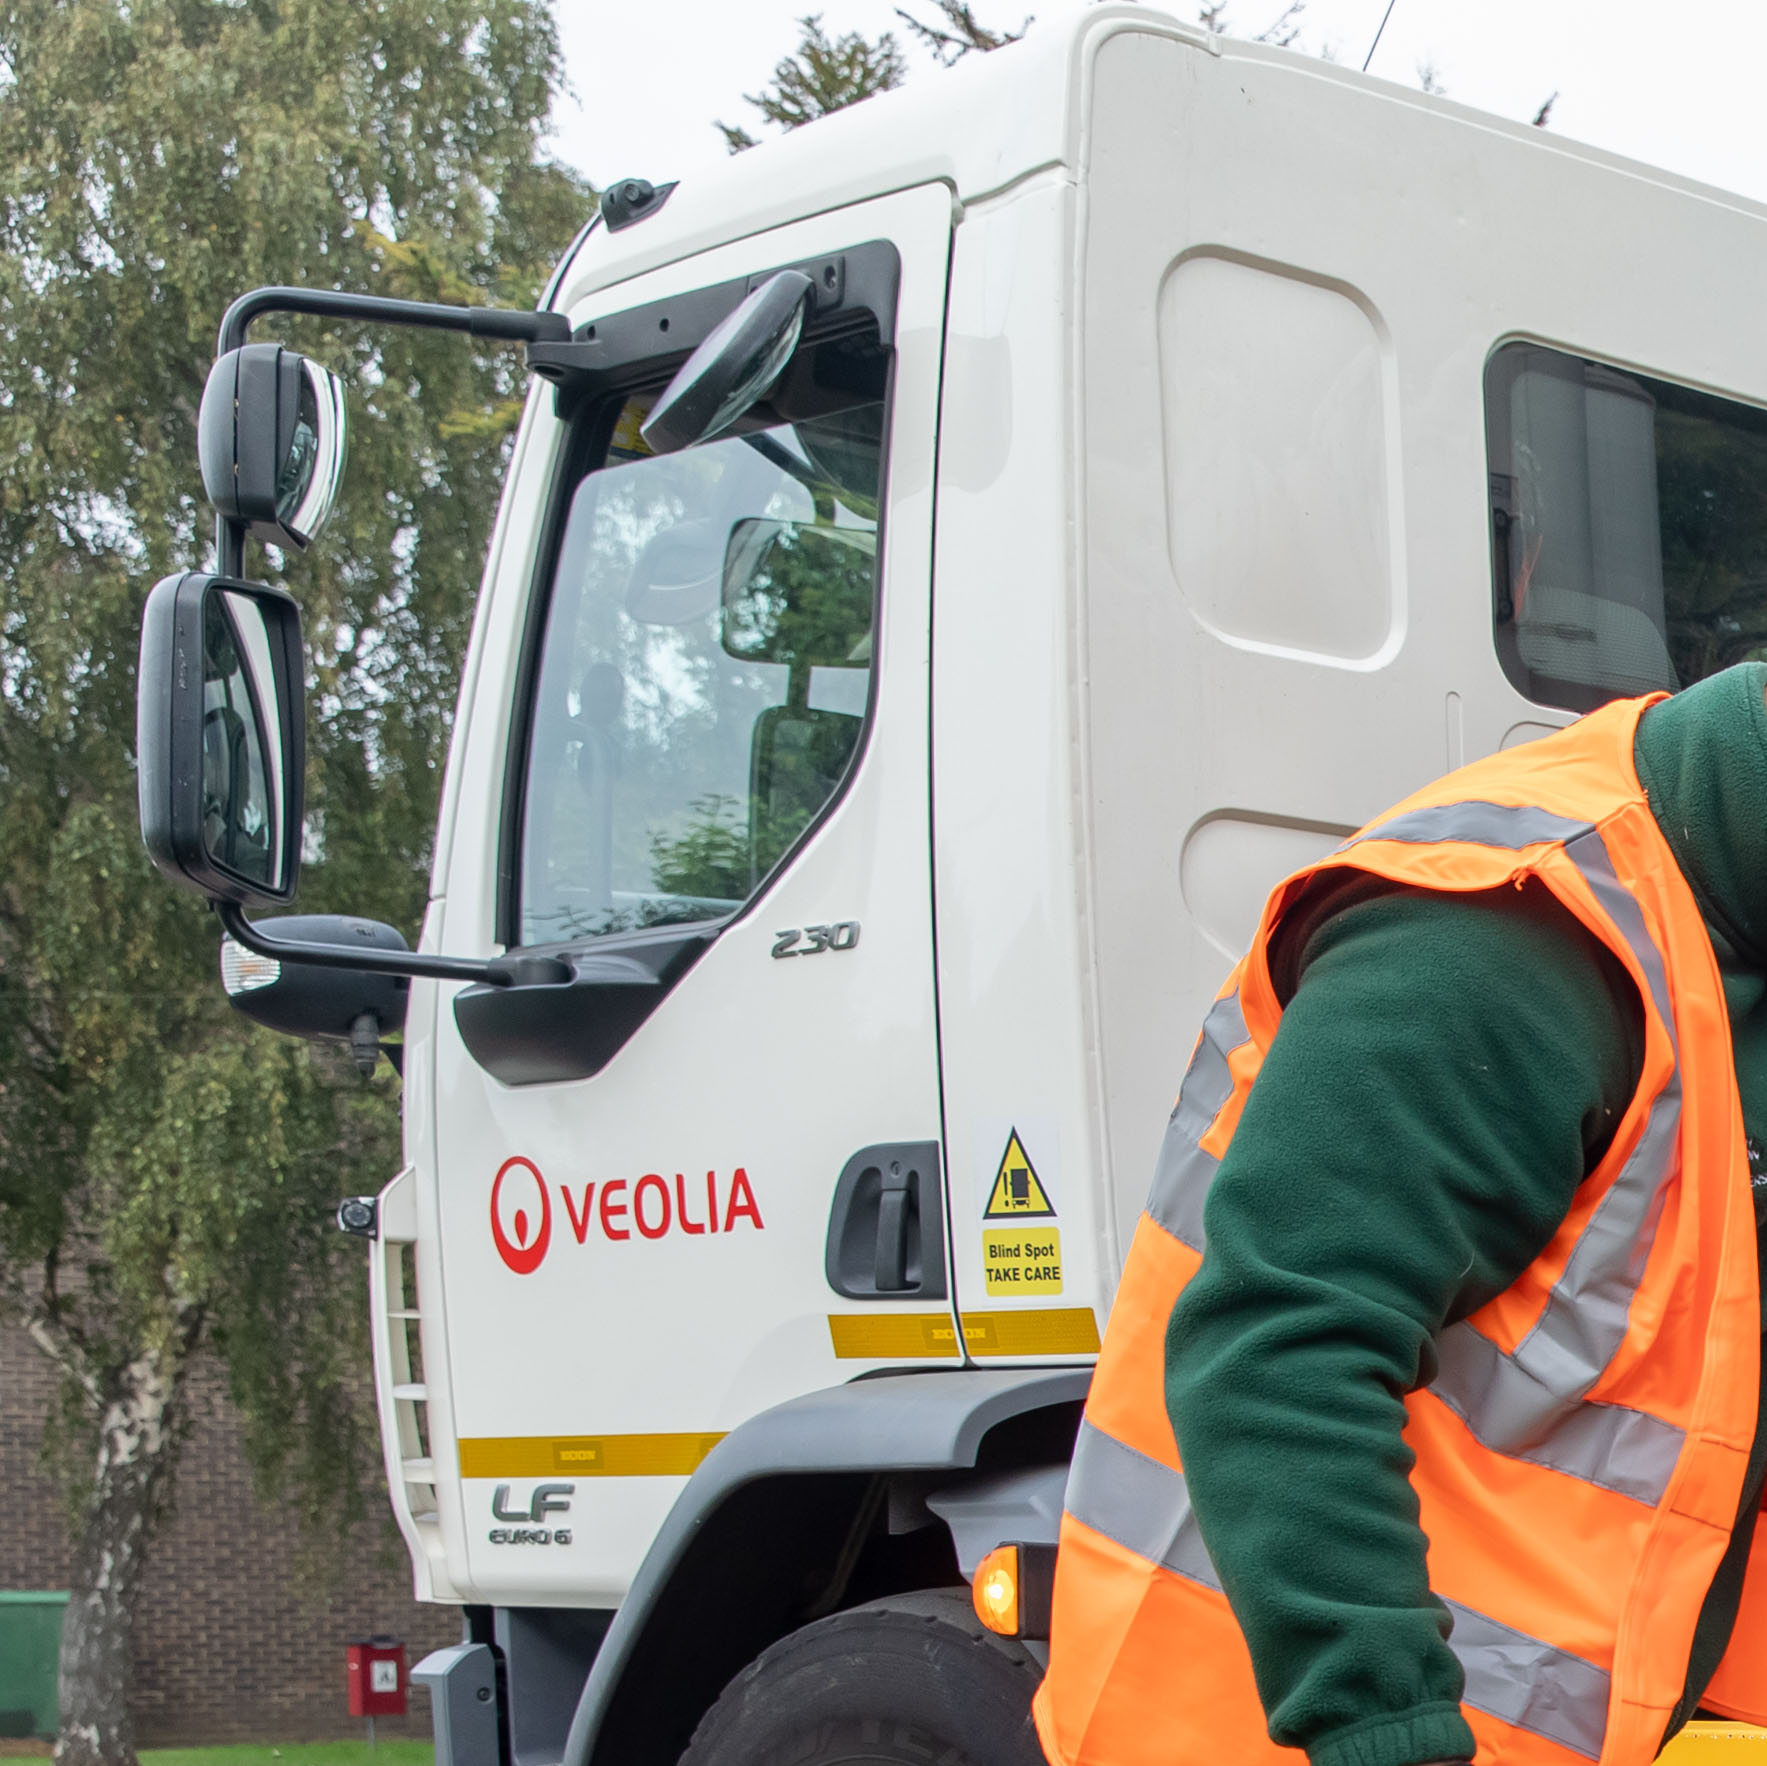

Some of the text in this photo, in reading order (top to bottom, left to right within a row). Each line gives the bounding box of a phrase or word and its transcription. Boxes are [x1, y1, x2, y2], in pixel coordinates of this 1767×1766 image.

[771, 921, 860, 959] 230
[560, 1168, 764, 1245] VEOLIA
[988, 1242, 1055, 1262] Blind Spot
[986, 1264, 1062, 1284] TAKE CARE
[491, 1482, 576, 1524] LF
